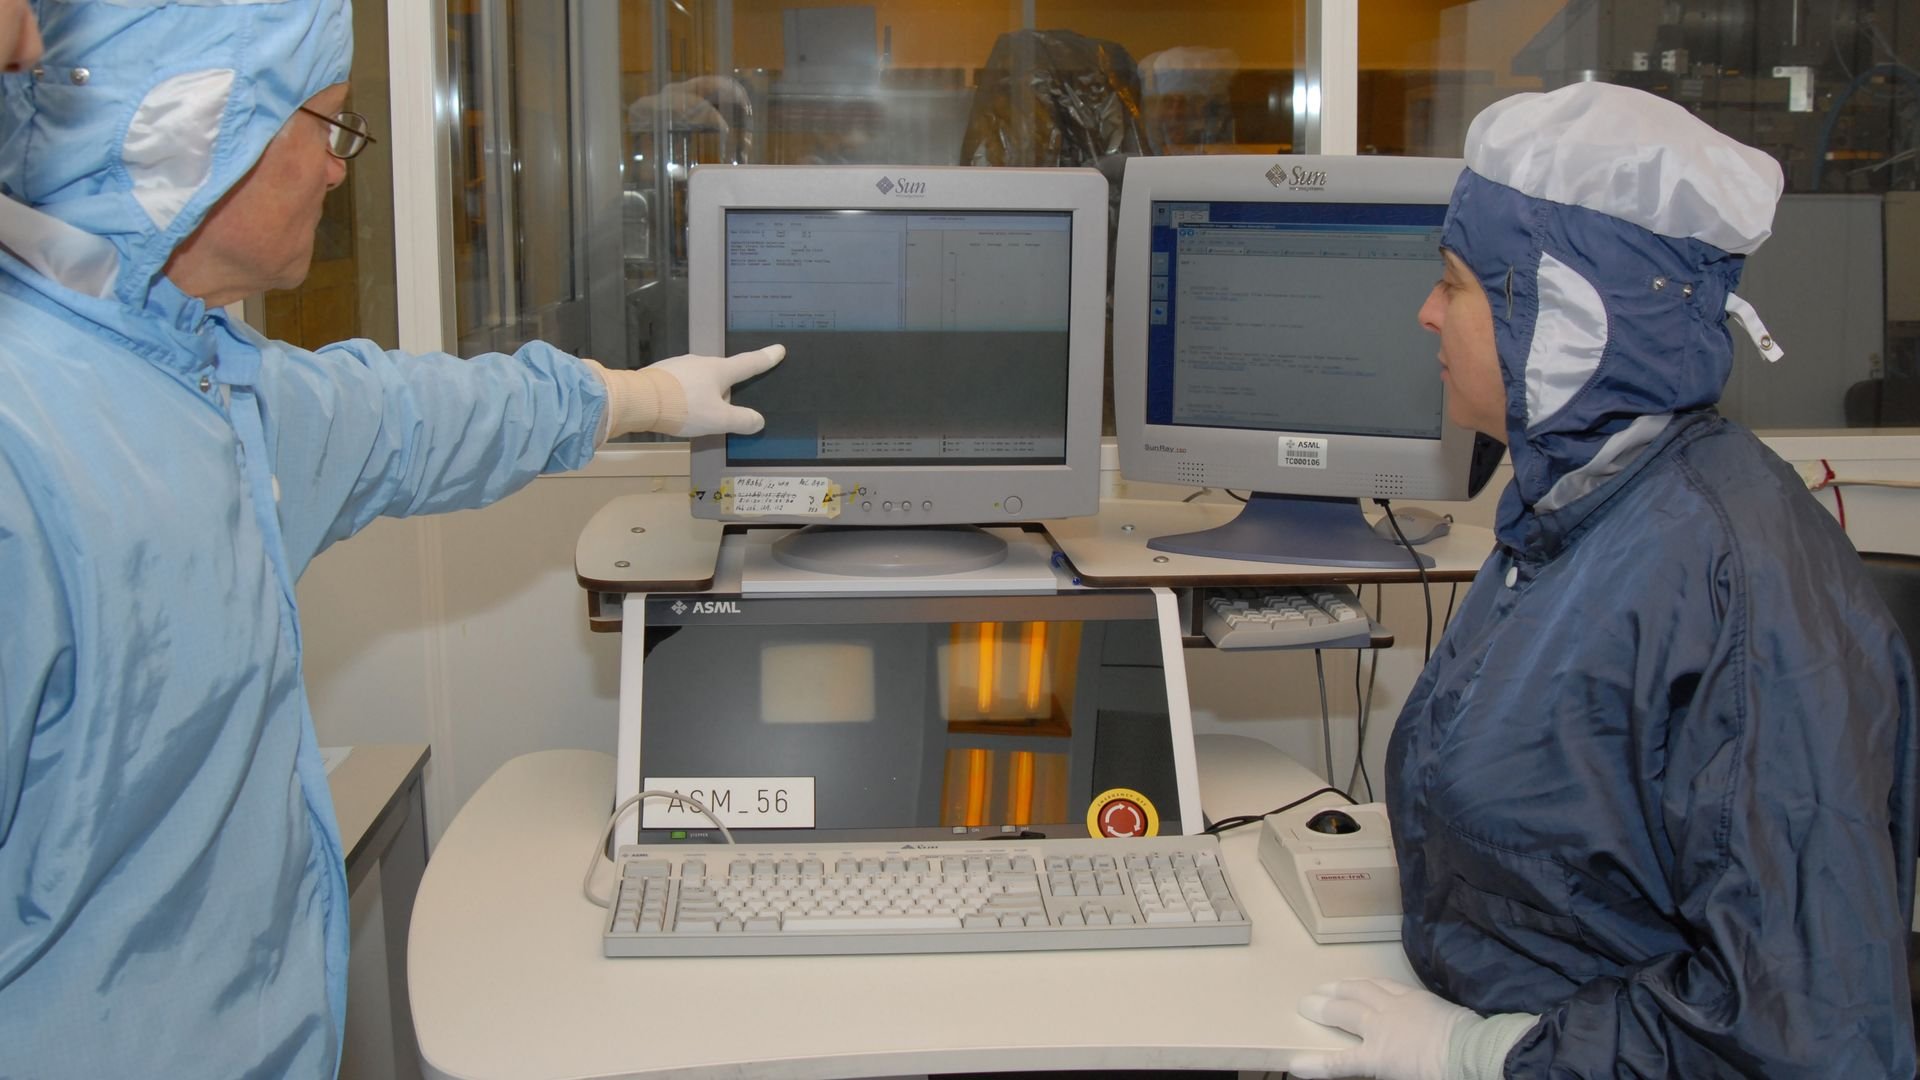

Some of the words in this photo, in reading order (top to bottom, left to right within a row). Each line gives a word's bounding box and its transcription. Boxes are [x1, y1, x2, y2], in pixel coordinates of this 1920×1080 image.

[1288, 165, 1327, 186] Sun
[895, 177, 926, 194] Sun
[1297, 441, 1321, 449] ASML
[1285, 457, 1321, 466] TC000106
[692, 601, 741, 614] ASML
[667, 789, 788, 813] ASM_56
